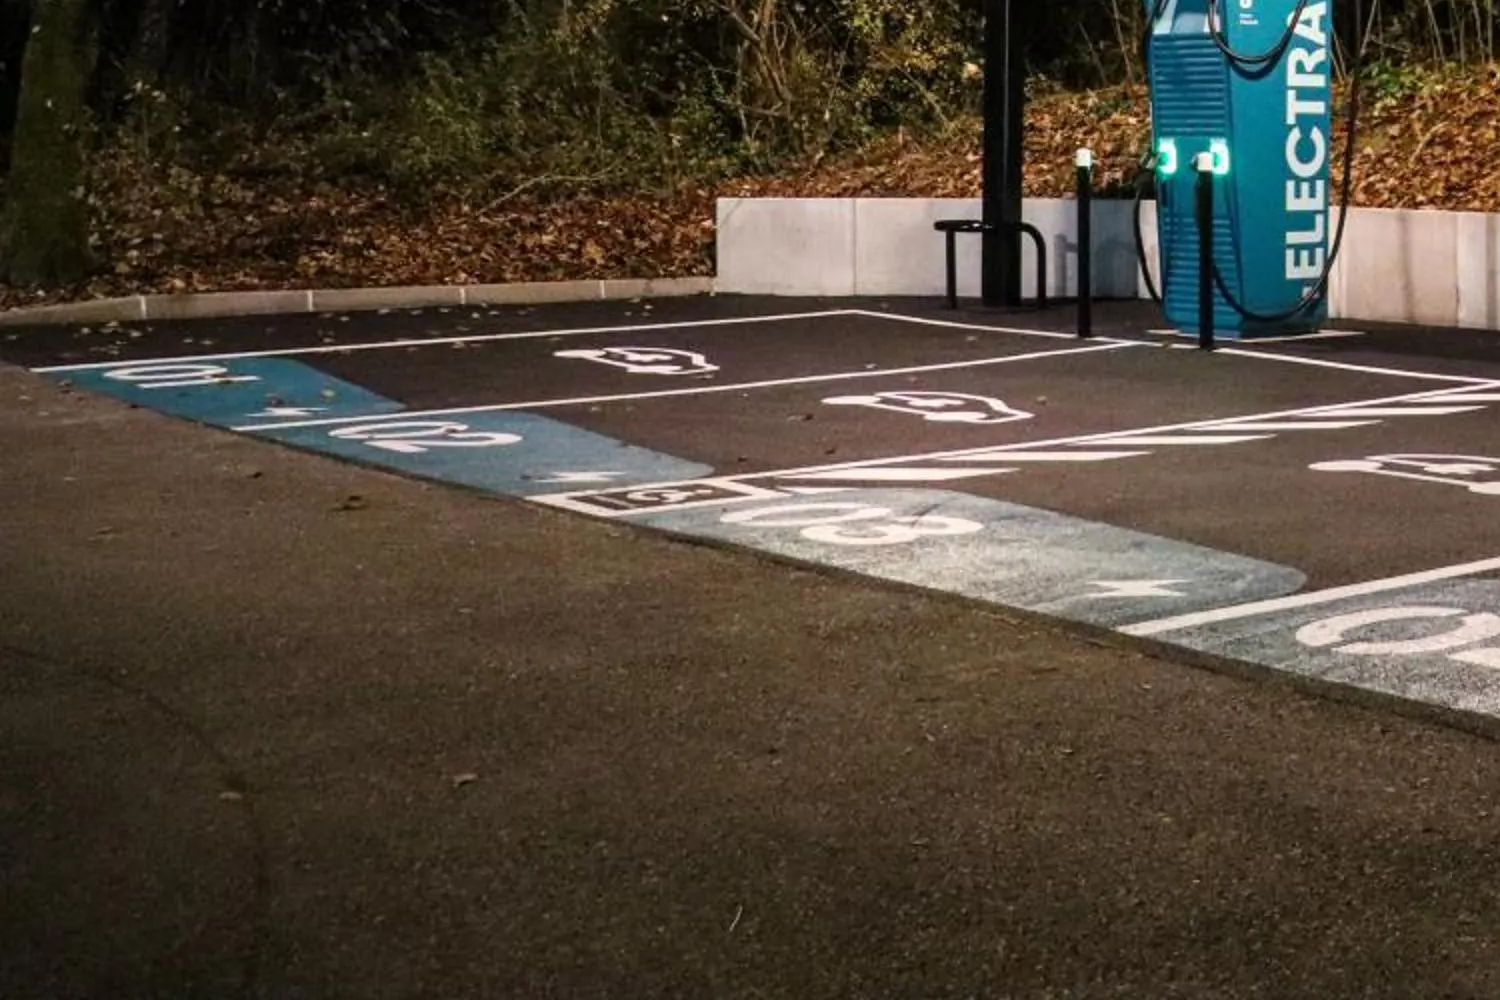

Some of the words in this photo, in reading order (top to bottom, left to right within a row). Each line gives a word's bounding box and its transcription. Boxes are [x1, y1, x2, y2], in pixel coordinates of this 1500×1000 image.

[1285, 0, 1327, 280] ELECTRA
[103, 362, 261, 389] 01
[328, 420, 524, 453] 02
[720, 503, 984, 545] 03
